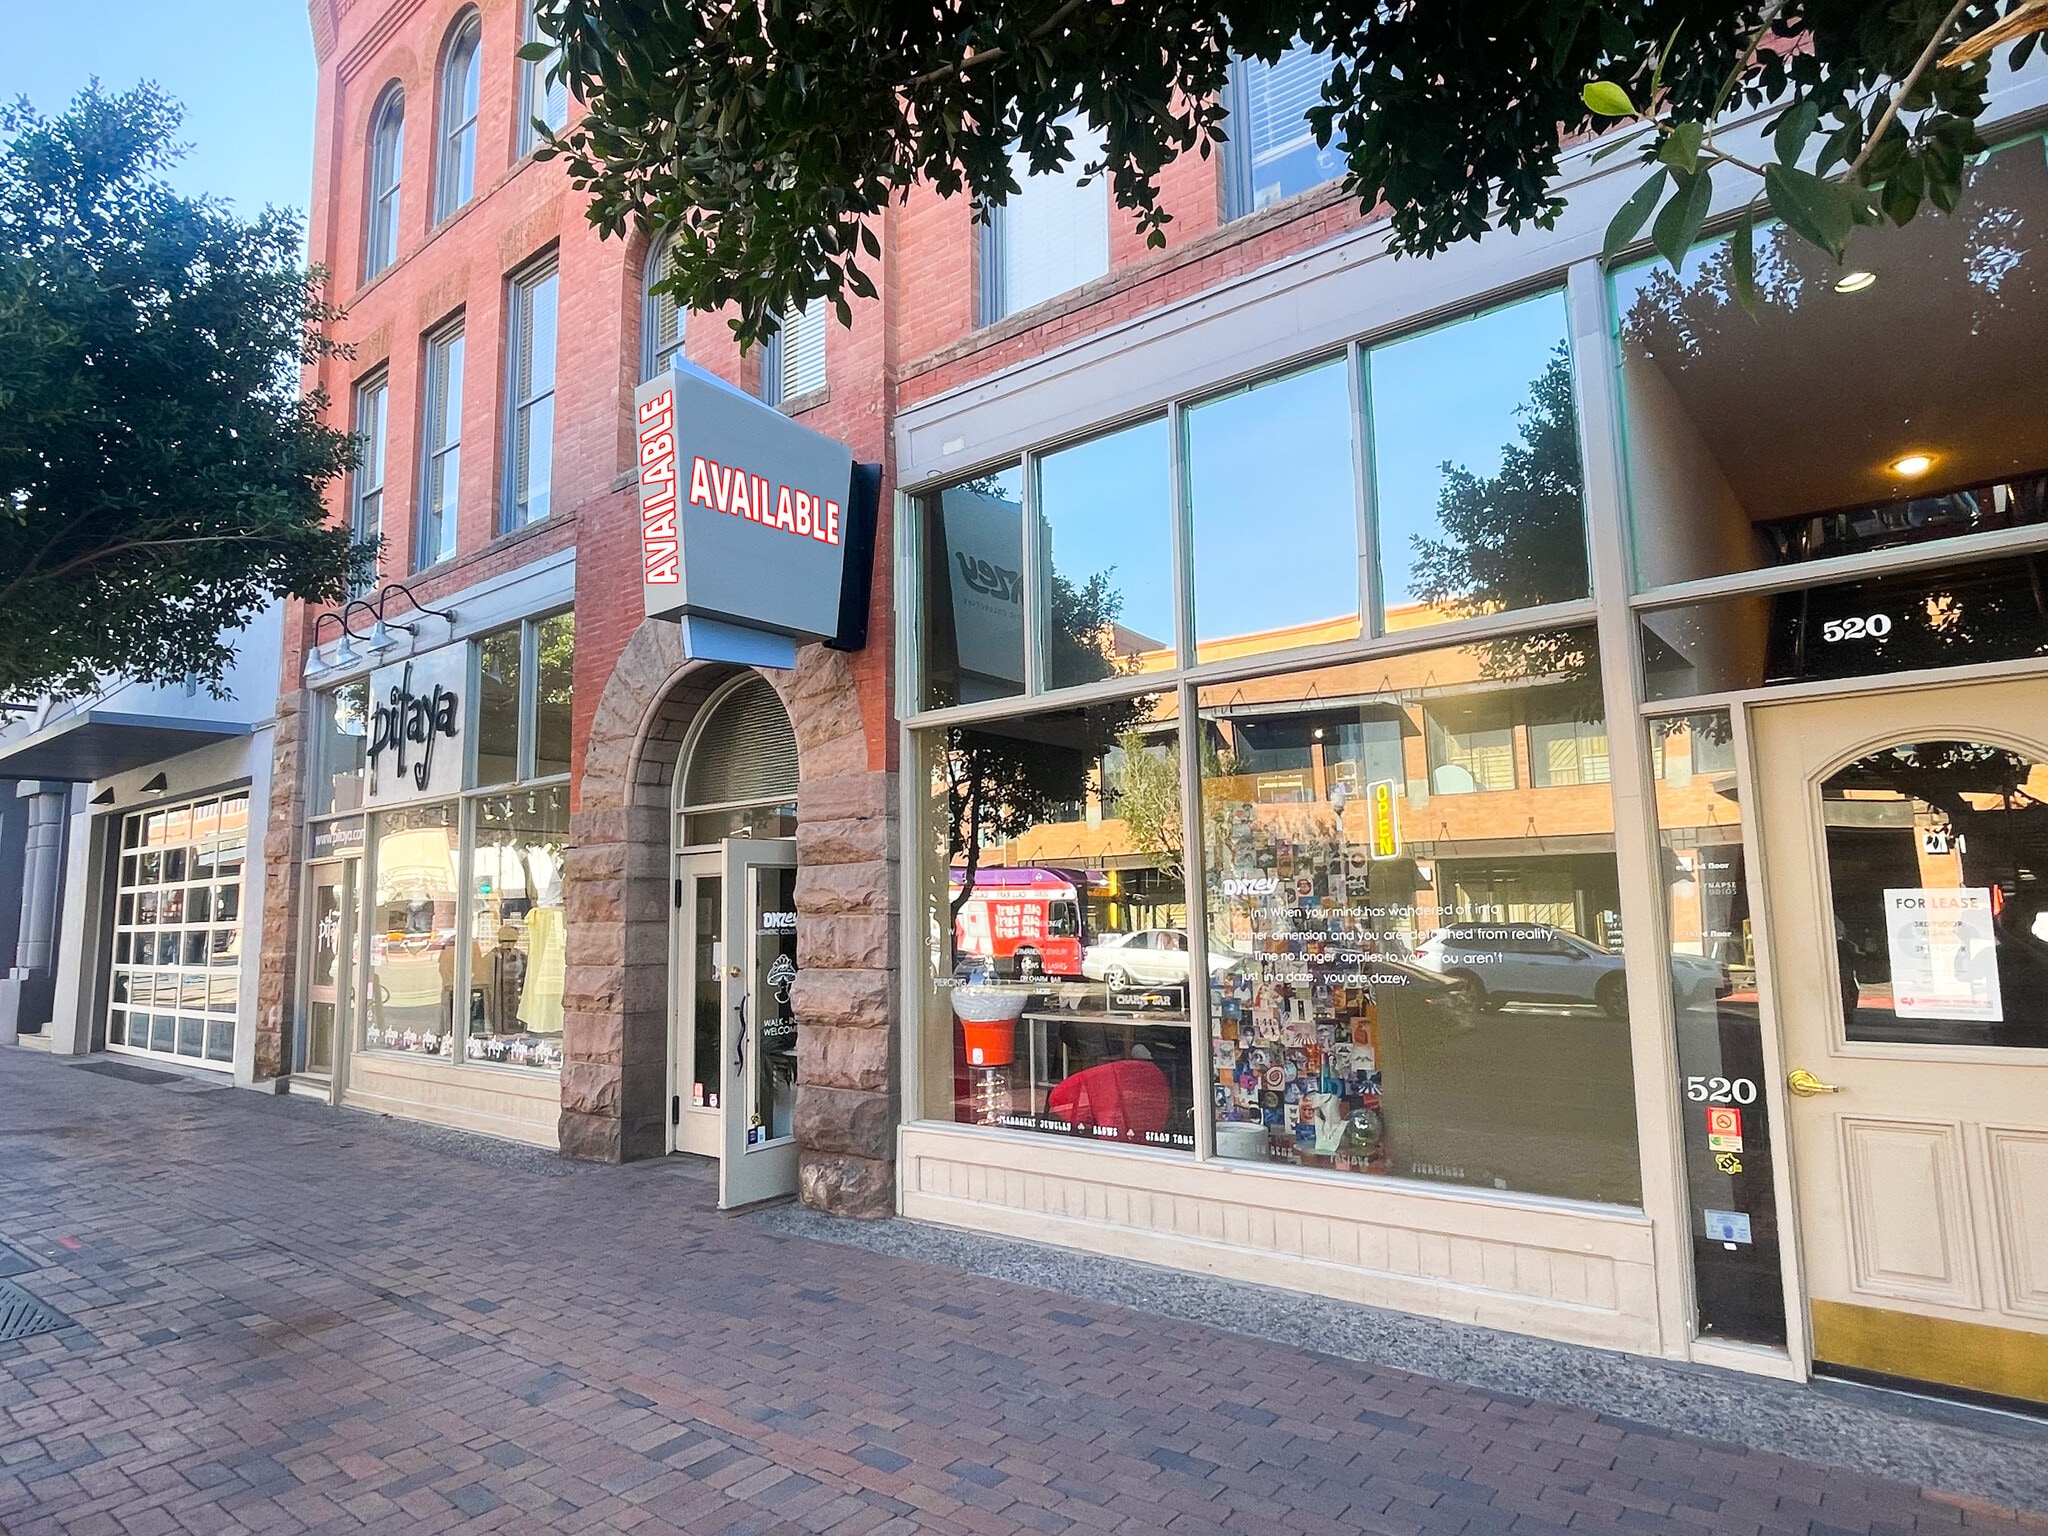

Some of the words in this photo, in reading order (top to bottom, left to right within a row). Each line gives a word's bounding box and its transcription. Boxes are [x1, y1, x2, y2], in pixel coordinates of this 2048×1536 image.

[639, 390, 678, 584] AVAILABLE
[689, 456, 840, 546] AVAILABLE
[1823, 613, 1892, 642] 520
[367, 660, 460, 797] pitaya
[1376, 784, 1393, 856] OPEN
[1270, 906, 1301, 919] When
[1305, 908, 1329, 920] your
[1332, 906, 1361, 917] mind
[1365, 906, 1386, 917] has
[1388, 904, 1453, 917] wandered
[1455, 903, 1473, 915] off
[1474, 903, 1501, 915] into
[1896, 898, 1926, 909] FOR
[1931, 897, 1979, 908] LEASE
[1271, 930, 1327, 941] dimension
[1331, 929, 1355, 941] and
[1357, 931, 1380, 942] you
[1383, 931, 1403, 941] are
[1410, 928, 1474, 940] detahed
[1477, 927, 1508, 940] from
[1254, 950, 1279, 962] Time
[1281, 951, 1296, 961] no
[1300, 951, 1335, 964] longer
[1340, 951, 1382, 965] applies
[1386, 951, 1398, 962] to
[1463, 951, 1503, 964] aren't
[1241, 971, 1259, 986] just
[1264, 971, 1273, 982] in
[1275, 973, 1284, 982] a
[1323, 973, 1345, 985] you
[1347, 973, 1368, 983] are
[1370, 973, 1411, 987] dazey.
[763, 1018, 784, 1027] WALK
[1687, 1077, 1757, 1105] 520
